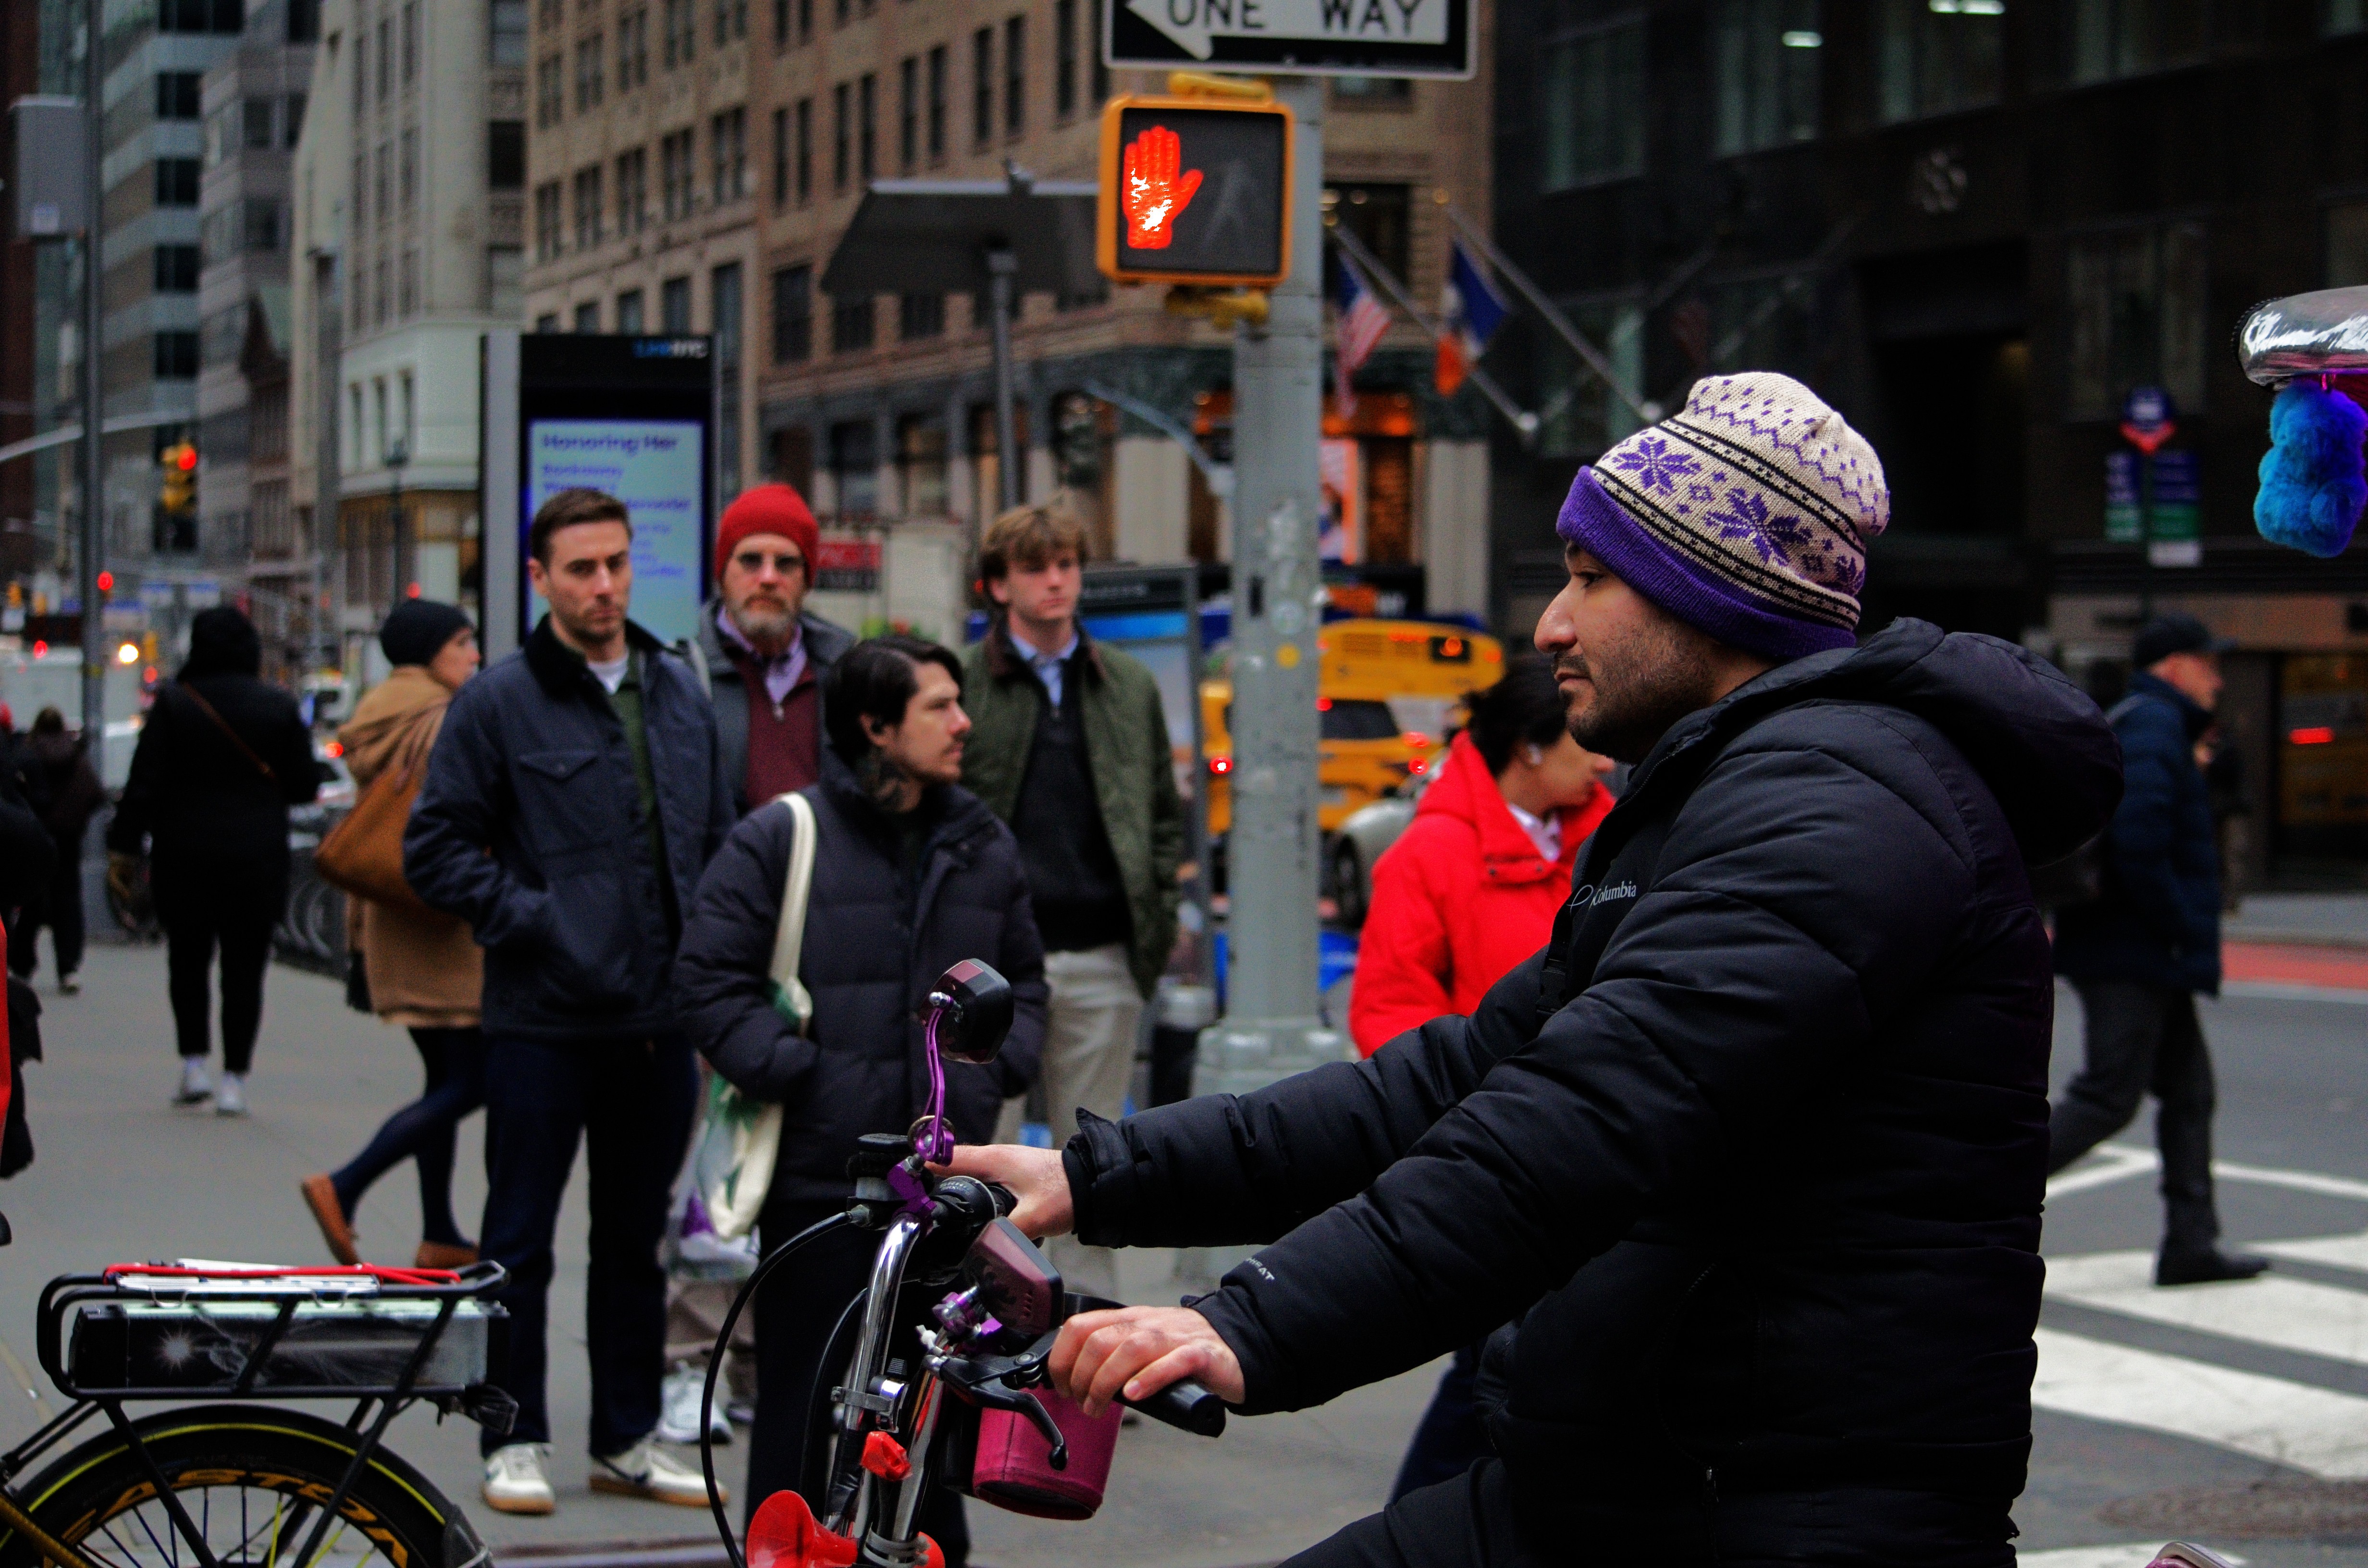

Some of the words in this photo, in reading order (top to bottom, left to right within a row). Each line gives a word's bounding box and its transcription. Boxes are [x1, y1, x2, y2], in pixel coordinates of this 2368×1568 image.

[1167, 0, 1265, 29] ONE
[1320, 0, 1422, 36] WAY
[1591, 881, 1637, 906] Columbia
